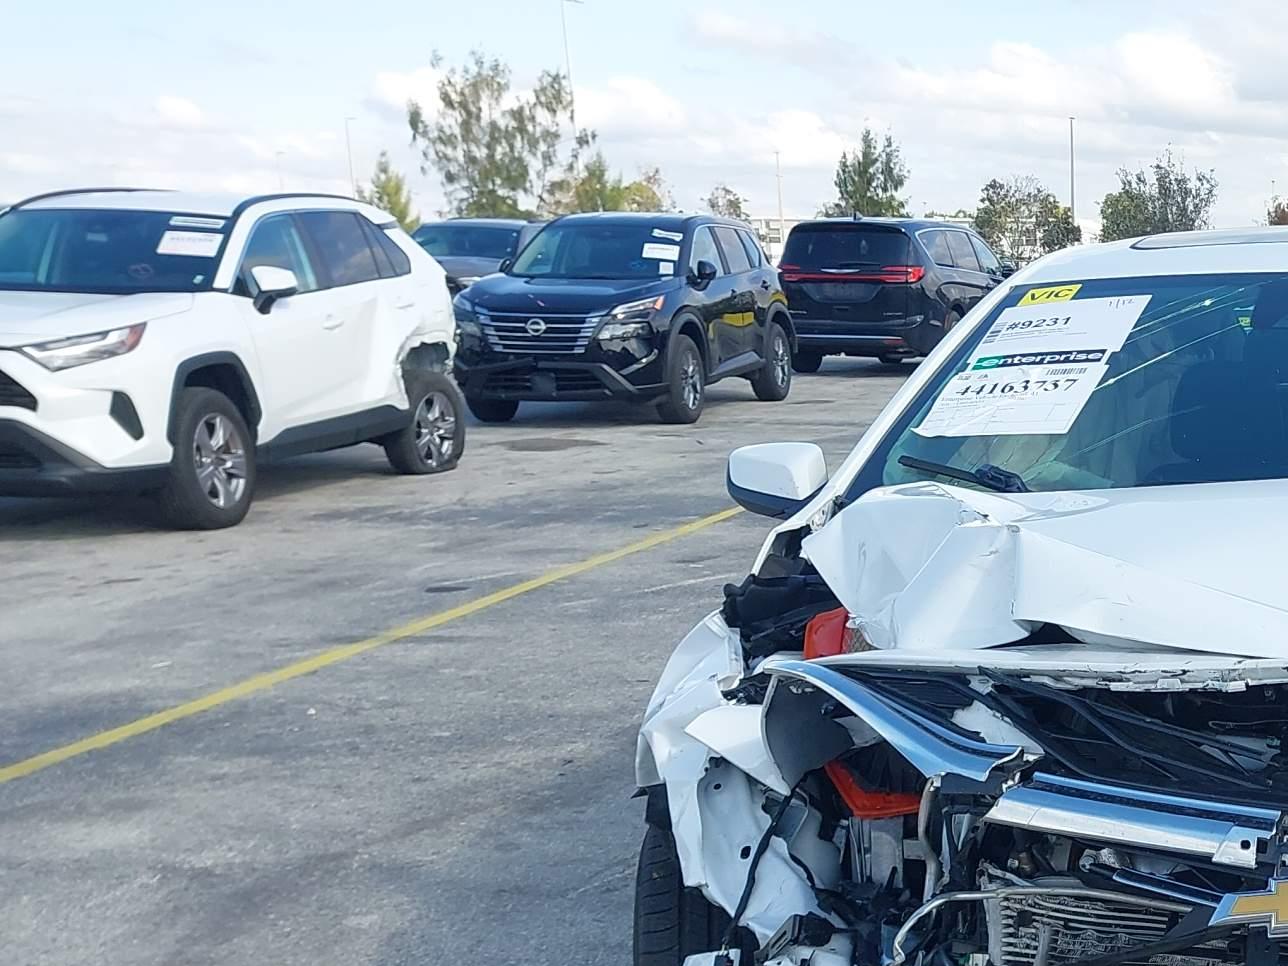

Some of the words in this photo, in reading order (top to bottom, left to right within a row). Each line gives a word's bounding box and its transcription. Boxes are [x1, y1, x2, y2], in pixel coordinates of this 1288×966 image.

[1030, 288, 1073, 301] VIC
[1005, 316, 1072, 332] #9231
[978, 351, 1103, 368] enterprise
